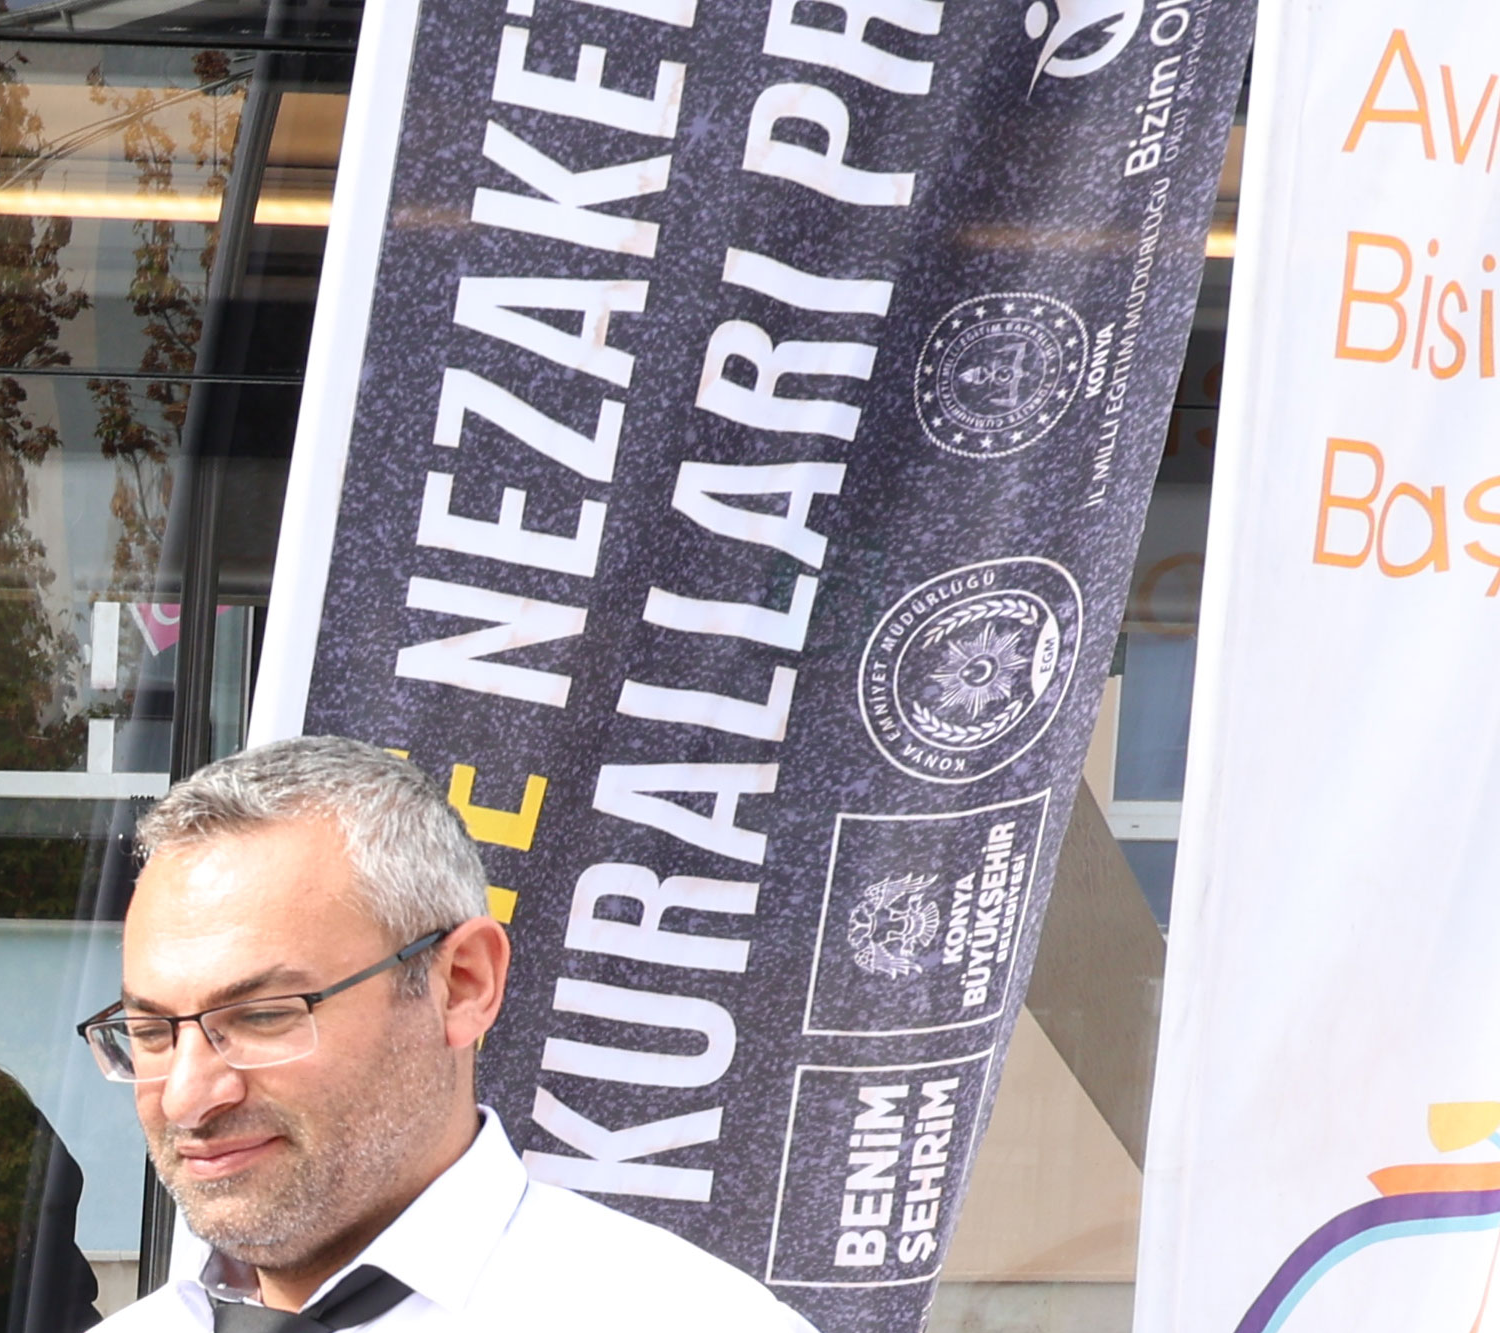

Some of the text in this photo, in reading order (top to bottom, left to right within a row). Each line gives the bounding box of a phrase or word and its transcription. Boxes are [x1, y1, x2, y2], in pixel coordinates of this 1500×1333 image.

[1124, 0, 1191, 177] Bizim O
[1085, 322, 1116, 400] KONYA
[1334, 230, 1497, 380] Bisi
[520, 0, 946, 1203] KURALLARI PR
[869, 569, 996, 772] KONYA EMNİYET MÜDÜRLÜĞÜ
[1040, 636, 1057, 673] EGM
[942, 872, 976, 965] KONYA
[960, 821, 1016, 1007] BÜYÜKŞEHİR
[997, 853, 1027, 963] BELEDİYESİ
[834, 1085, 910, 1266] BENİM
[898, 1077, 960, 1263] ŞEHRİM
